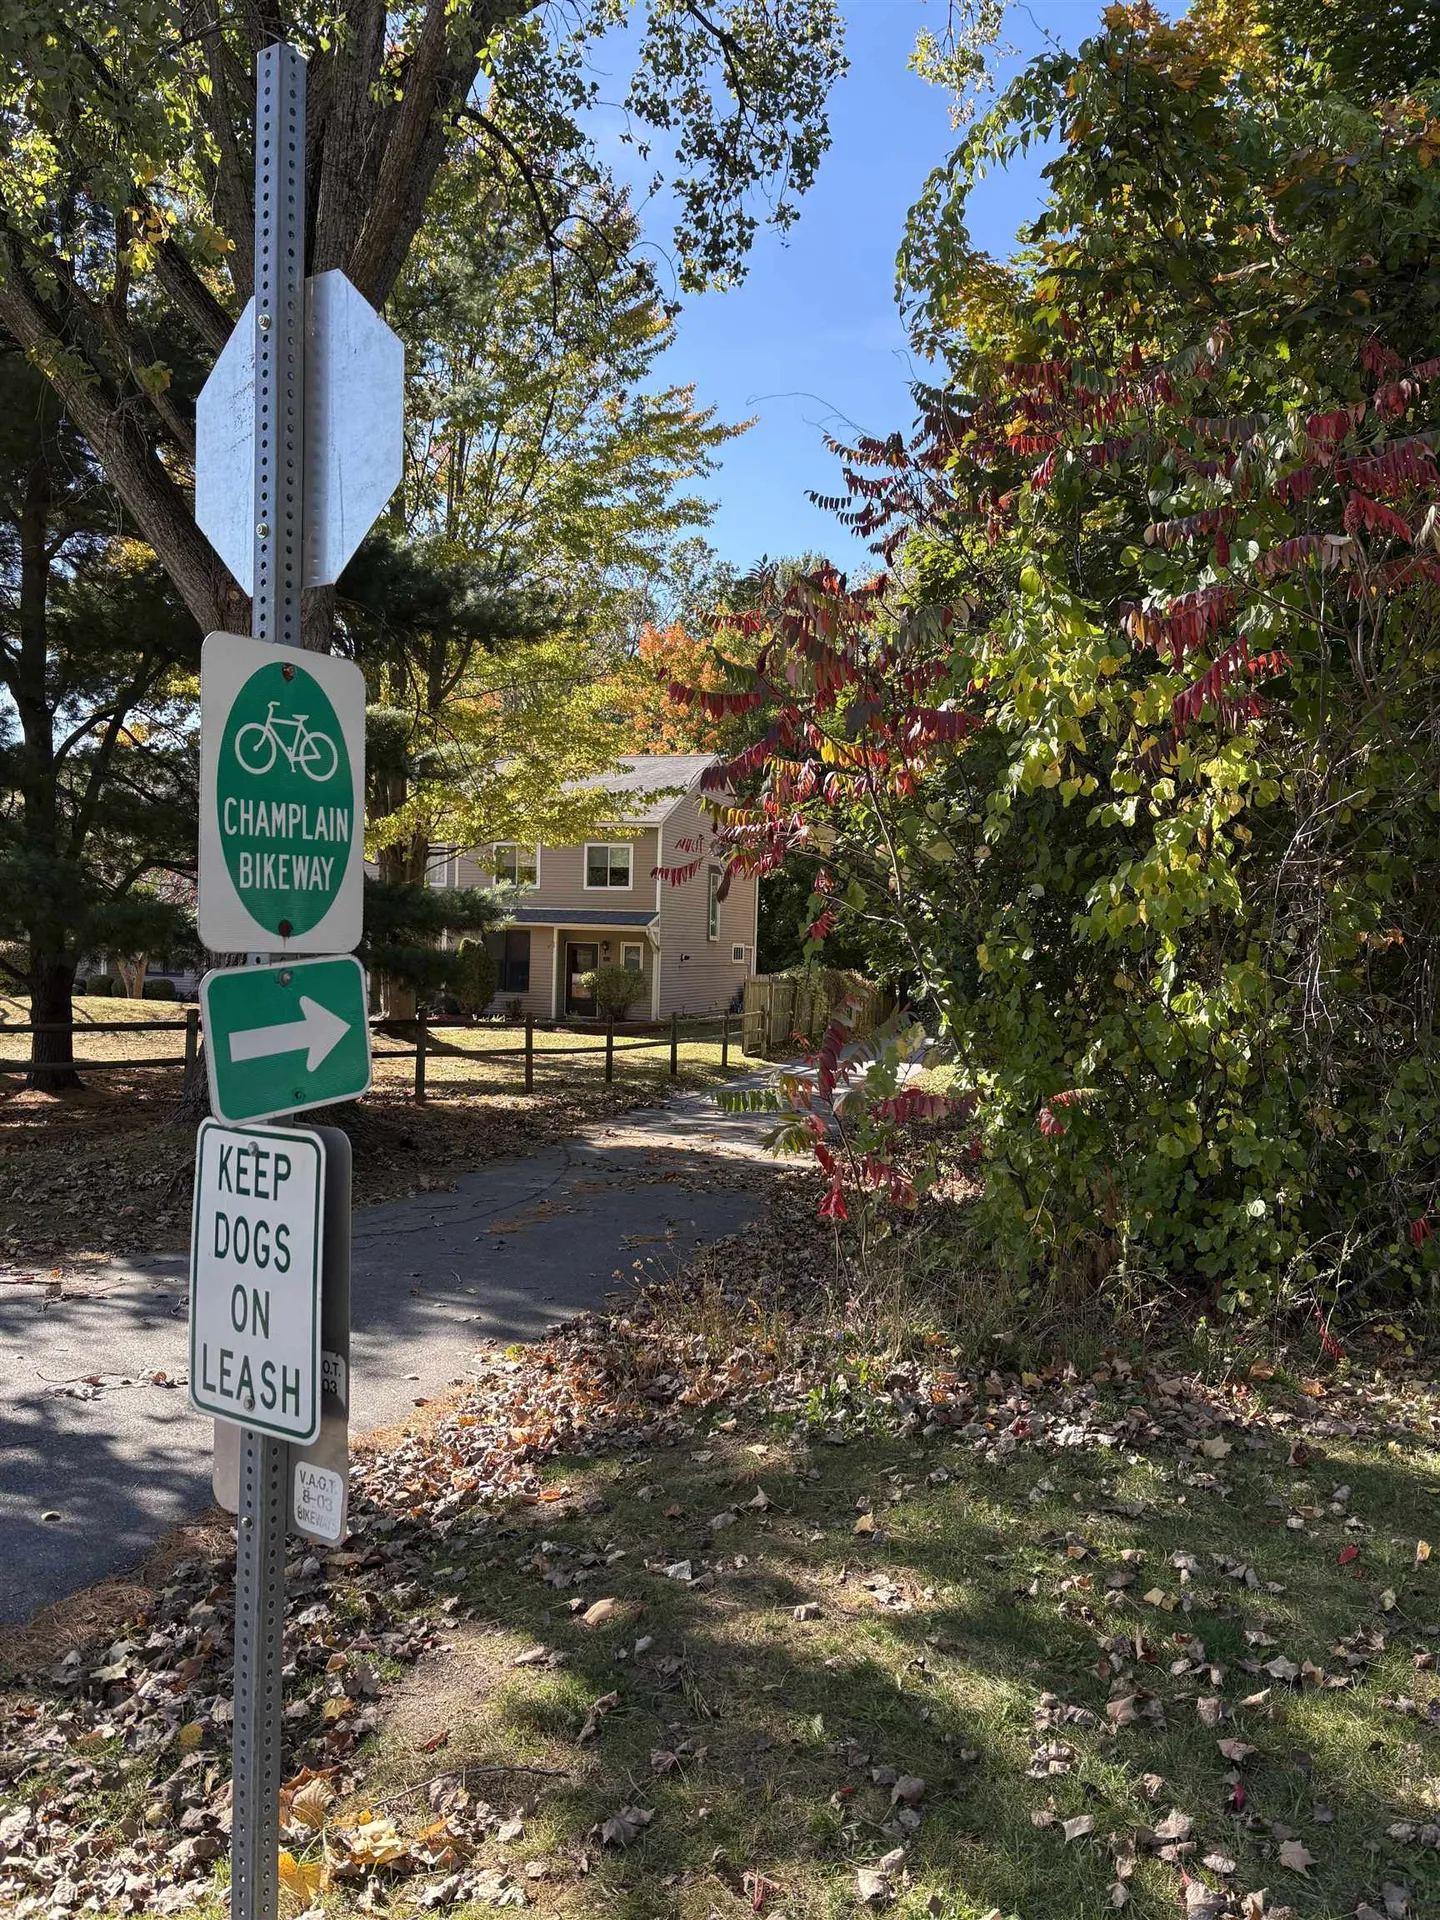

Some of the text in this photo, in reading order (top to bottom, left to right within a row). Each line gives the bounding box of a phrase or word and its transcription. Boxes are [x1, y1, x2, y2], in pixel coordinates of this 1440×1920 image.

[223, 797, 348, 842] CHAMPLAIN
[239, 852, 335, 891] BIKEWAY
[218, 1143, 292, 1201] KEEP
[214, 1211, 291, 1274] DOGS
[231, 1284, 270, 1340] ON
[202, 1343, 300, 1417] LEASH
[321, 1359, 342, 1378] O.T.
[321, 1378, 338, 1395] 03
[299, 1469, 338, 1495] V.A.O.T.
[302, 1489, 333, 1513] 8-03
